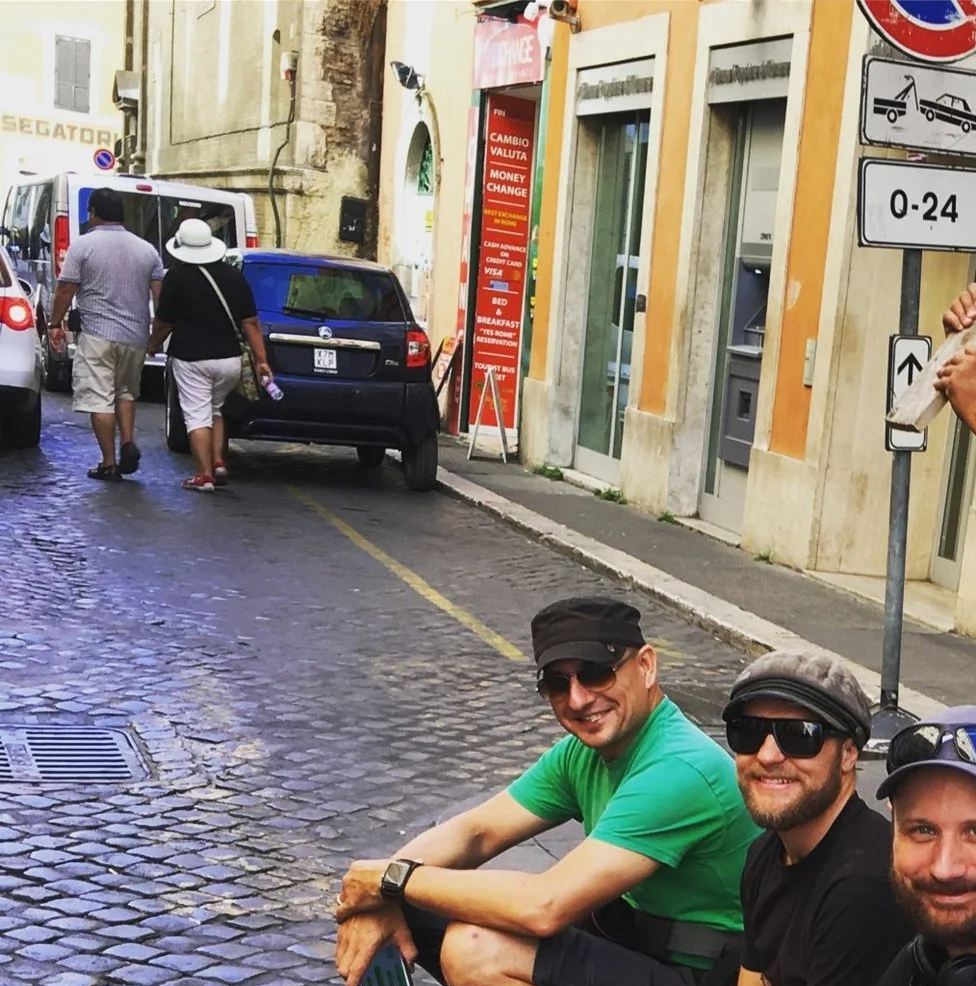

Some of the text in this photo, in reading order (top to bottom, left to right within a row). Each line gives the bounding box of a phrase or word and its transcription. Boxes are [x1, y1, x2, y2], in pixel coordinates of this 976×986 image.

[490, 132, 530, 148] CAMBIO
[490, 146, 528, 161] VALUTA
[489, 169, 526, 184] MONEY
[486, 182, 528, 198] CHANGE
[890, 189, 958, 223] 0-24
[484, 241, 526, 253] CASH ADVANCE
[486, 256, 522, 268] CREDIT CARD
[484, 266, 503, 277] VISA
[492, 297, 508, 306] BED
[495, 308, 503, 316] &
[477, 315, 520, 329] BREAKFAST
[476, 336, 518, 347] RESERVATION
[502, 366, 516, 374] BUS
